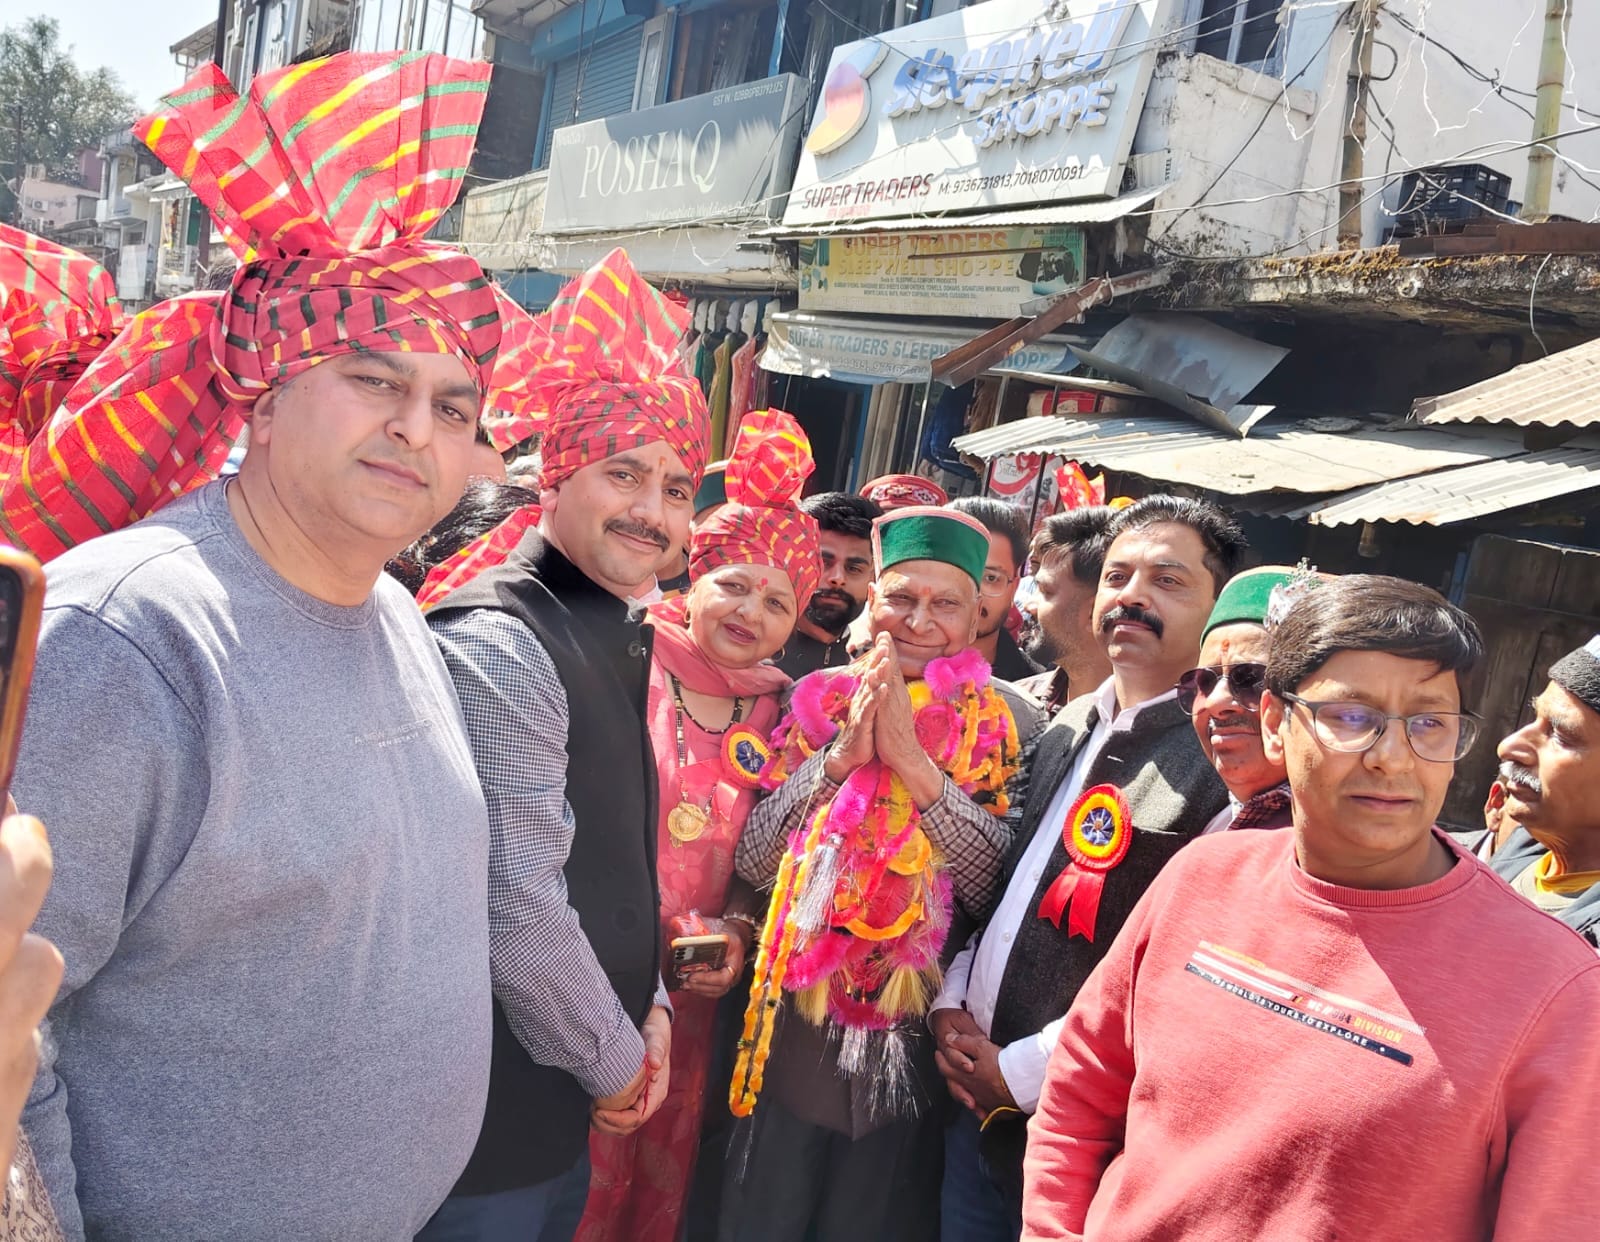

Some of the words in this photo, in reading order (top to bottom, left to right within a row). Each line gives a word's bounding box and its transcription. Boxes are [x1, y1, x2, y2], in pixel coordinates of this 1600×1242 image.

[578, 119, 721, 198] POSHAQ
[802, 184, 851, 209] SUPER
[854, 173, 934, 204] TRADERS
[843, 235, 900, 257] SUPER
[908, 232, 1009, 254] TRADERS
[830, 335, 890, 357] TRADERS
[1267, 1000, 1300, 1019] YOURS
[1315, 1021, 1368, 1047] EXPLORE
[1353, 1016, 1404, 1044] DIVISION
